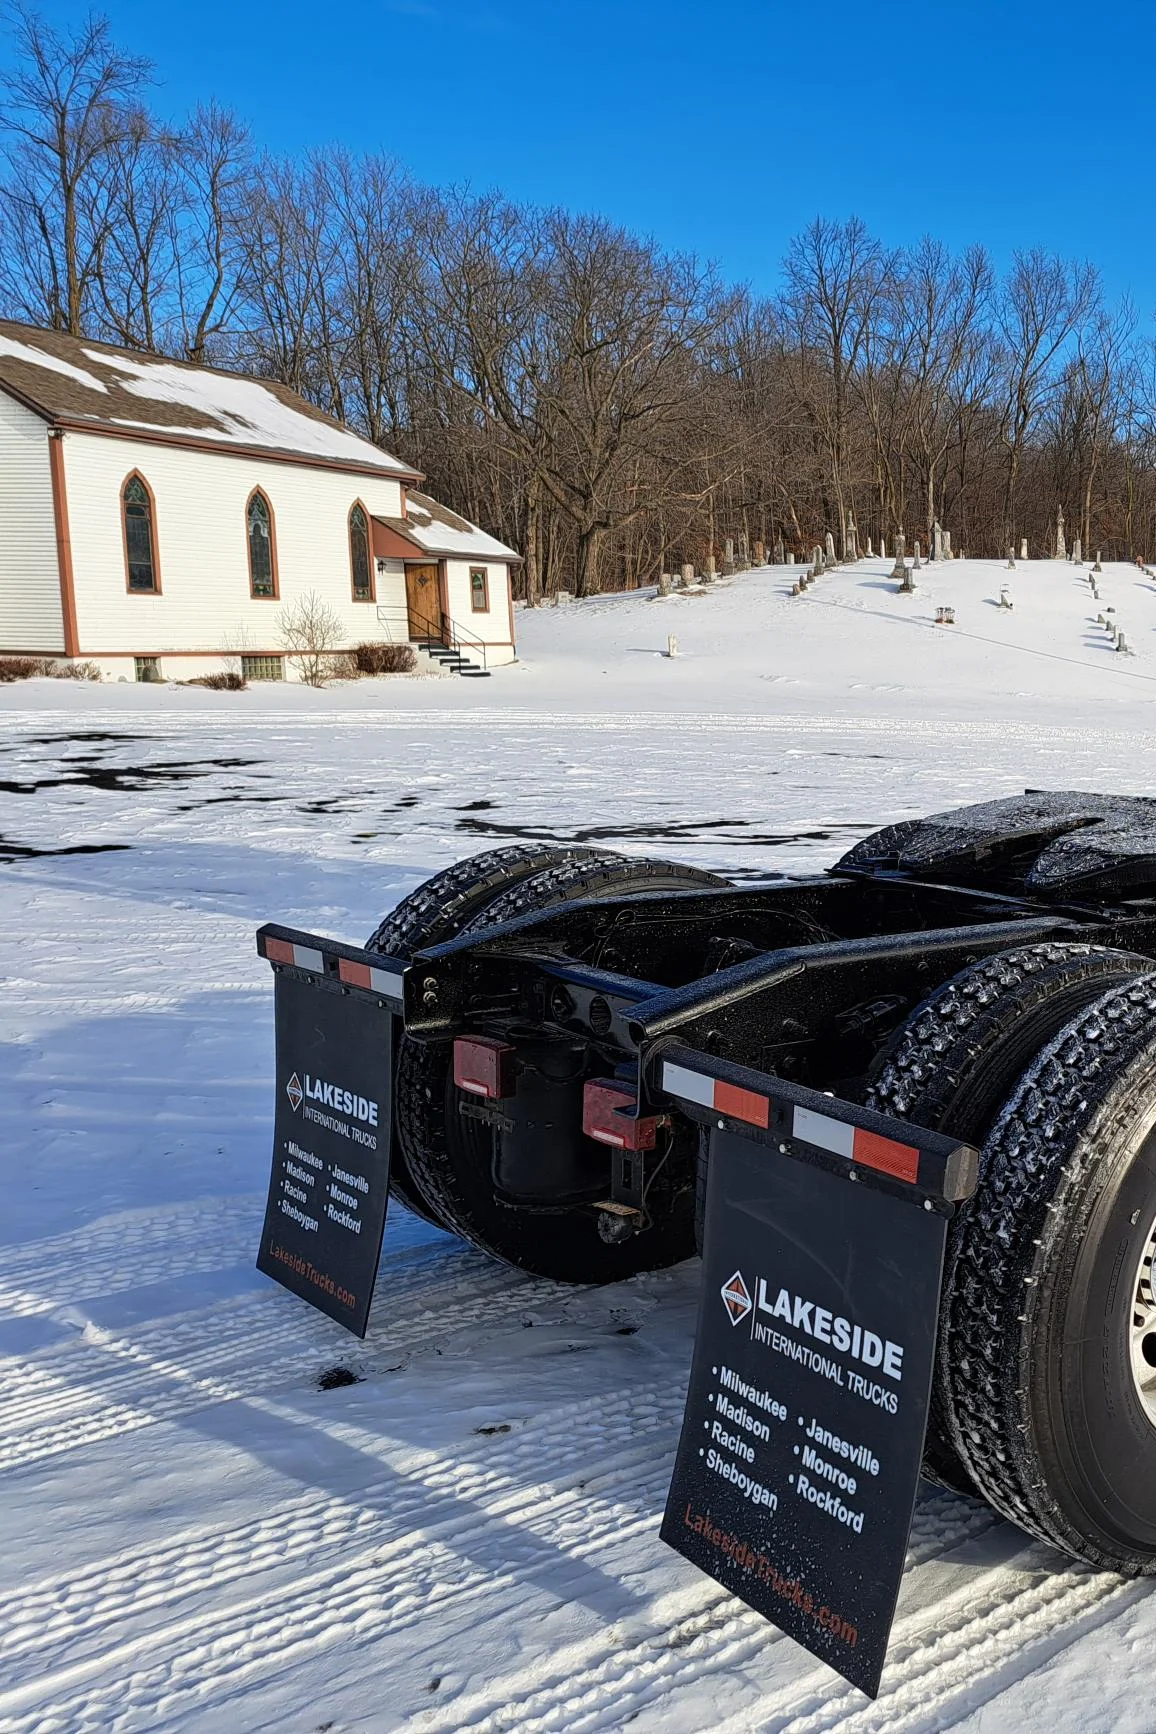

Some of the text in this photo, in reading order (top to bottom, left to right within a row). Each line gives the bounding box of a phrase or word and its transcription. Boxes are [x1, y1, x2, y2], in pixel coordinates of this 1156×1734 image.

[305, 1074, 378, 1127] LAKESIDE
[305, 1106, 377, 1151] INTERNATIONAL TRUCKS
[287, 1160, 315, 1187] Madison
[288, 1140, 323, 1170] Milwaukee
[332, 1164, 369, 1194] Janesville
[281, 1199, 319, 1233] Sheboygan
[284, 1180, 307, 1204] Racine
[330, 1183, 358, 1210] Monroe
[327, 1204, 361, 1234] Rockford
[269, 1240, 356, 1308] LakesideTrucks.com
[758, 1278, 904, 1381] LAKESIDE
[755, 1322, 898, 1415] INTERNATIONAL TRUCKS
[716, 1393, 770, 1442] Madison
[720, 1366, 787, 1421] Milwaukee
[712, 1421, 755, 1464] Racine
[806, 1418, 880, 1476] Janesville
[706, 1449, 778, 1511] Sheboygan
[802, 1445, 857, 1495] Monroe
[796, 1478, 864, 1534] Rockford
[684, 1504, 858, 1647] LakesideTrucks.com
